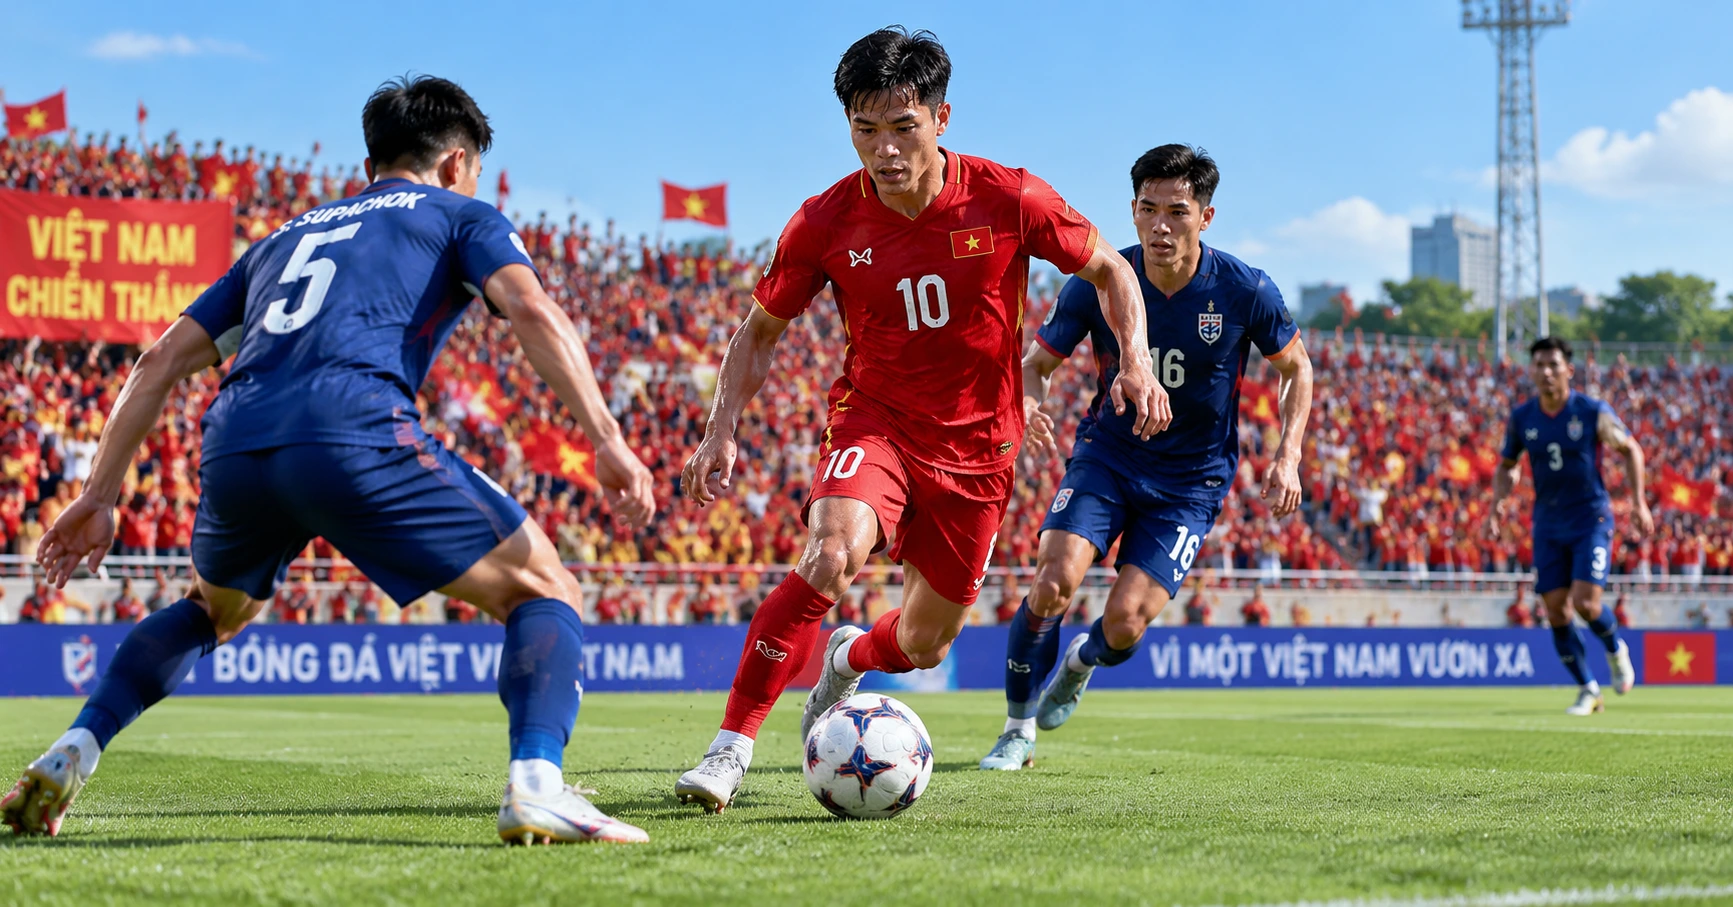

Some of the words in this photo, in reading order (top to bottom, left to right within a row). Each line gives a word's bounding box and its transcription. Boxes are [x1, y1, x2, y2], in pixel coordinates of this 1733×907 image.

[295, 192, 427, 227] SUPACHOK
[27, 207, 109, 267] VIỆT
[117, 221, 196, 266] NAM
[263, 222, 362, 334] 5
[896, 274, 950, 331] 10
[1150, 347, 1185, 388] 16
[822, 446, 865, 483] 10
[1547, 442, 1563, 471] 3
[1169, 525, 1199, 570] 16
[1592, 547, 1606, 571] 3
[387, 633, 464, 691] VIỆT
[1188, 633, 1257, 686] MỘT
[1261, 633, 1328, 686] VIỆT
[1334, 642, 1400, 679] NAM
[1494, 642, 1535, 678] XA
